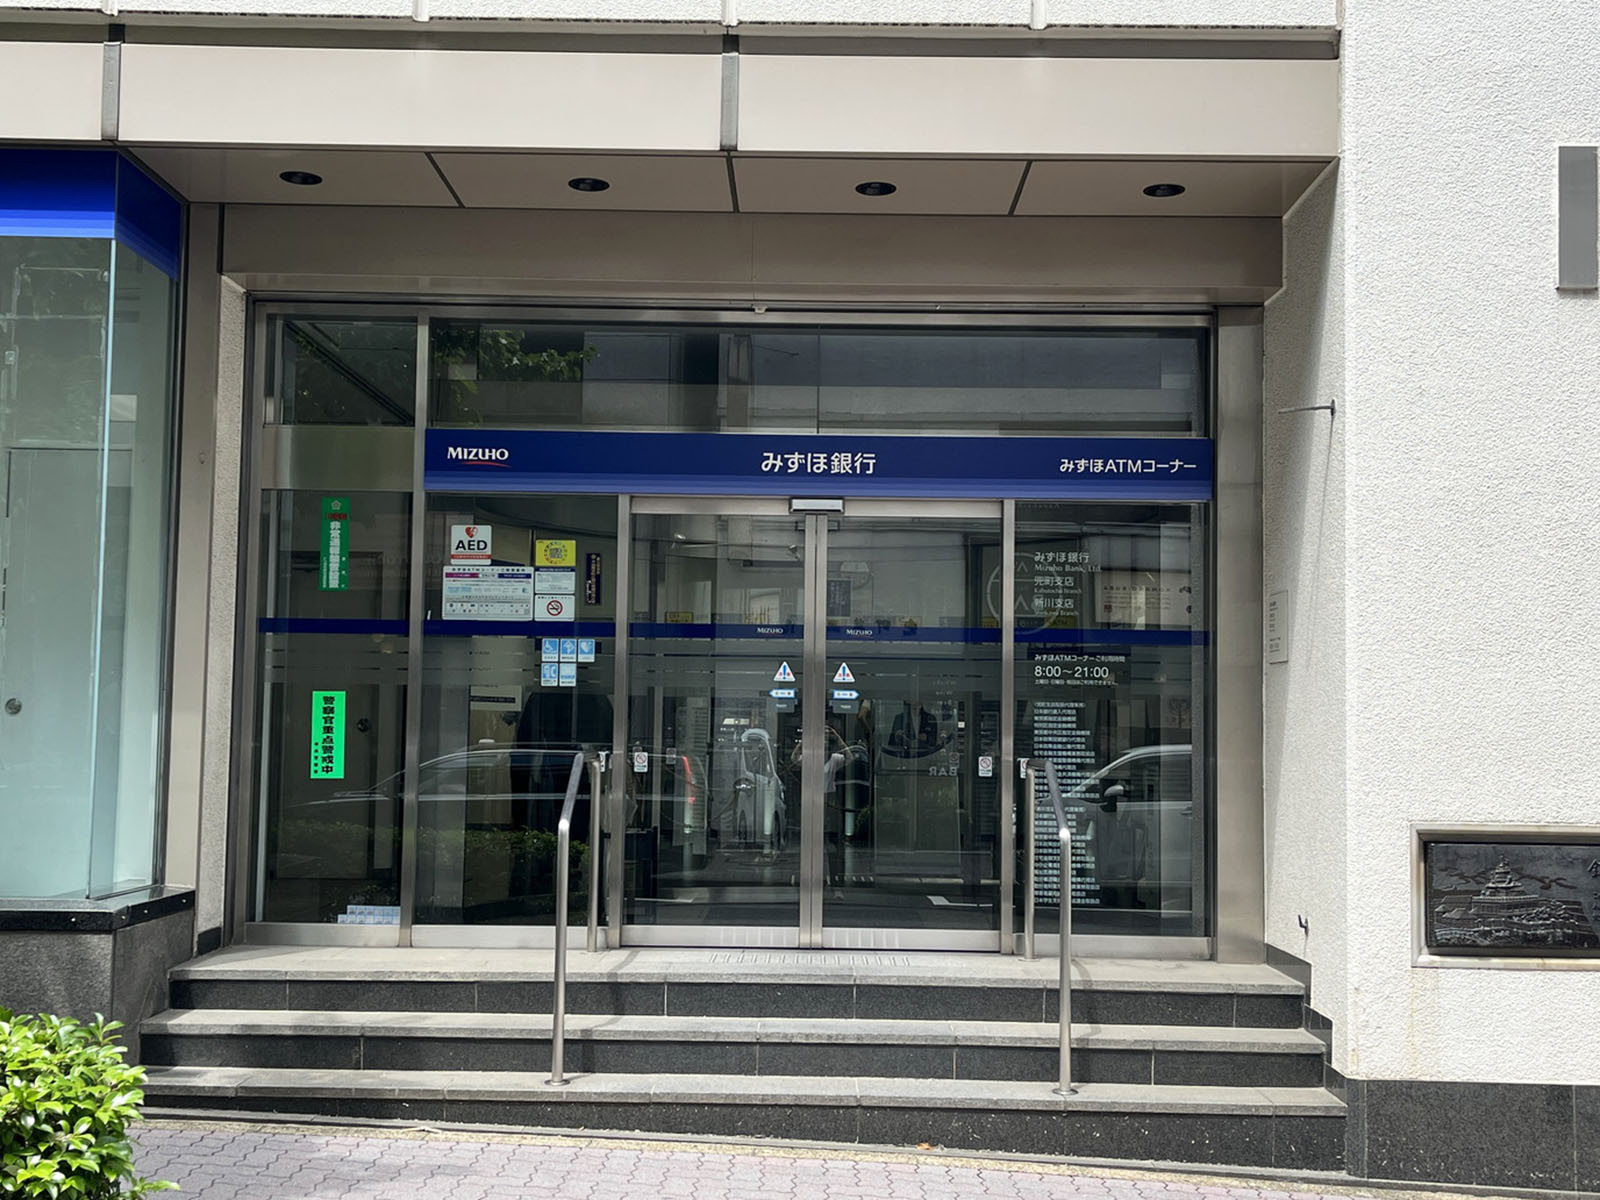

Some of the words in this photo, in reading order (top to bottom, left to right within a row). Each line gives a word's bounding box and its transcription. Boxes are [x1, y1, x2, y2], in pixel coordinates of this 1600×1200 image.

[447, 446, 509, 461] MIZUHO
[760, 451, 877, 475] みずほ銀行
[1059, 457, 1197, 474] みずほATMコーナー
[455, 539, 488, 551] AED
[1034, 551, 1090, 563] みずほ銀行
[757, 626, 784, 634] MIZUHO
[846, 628, 873, 636] MIZUHO
